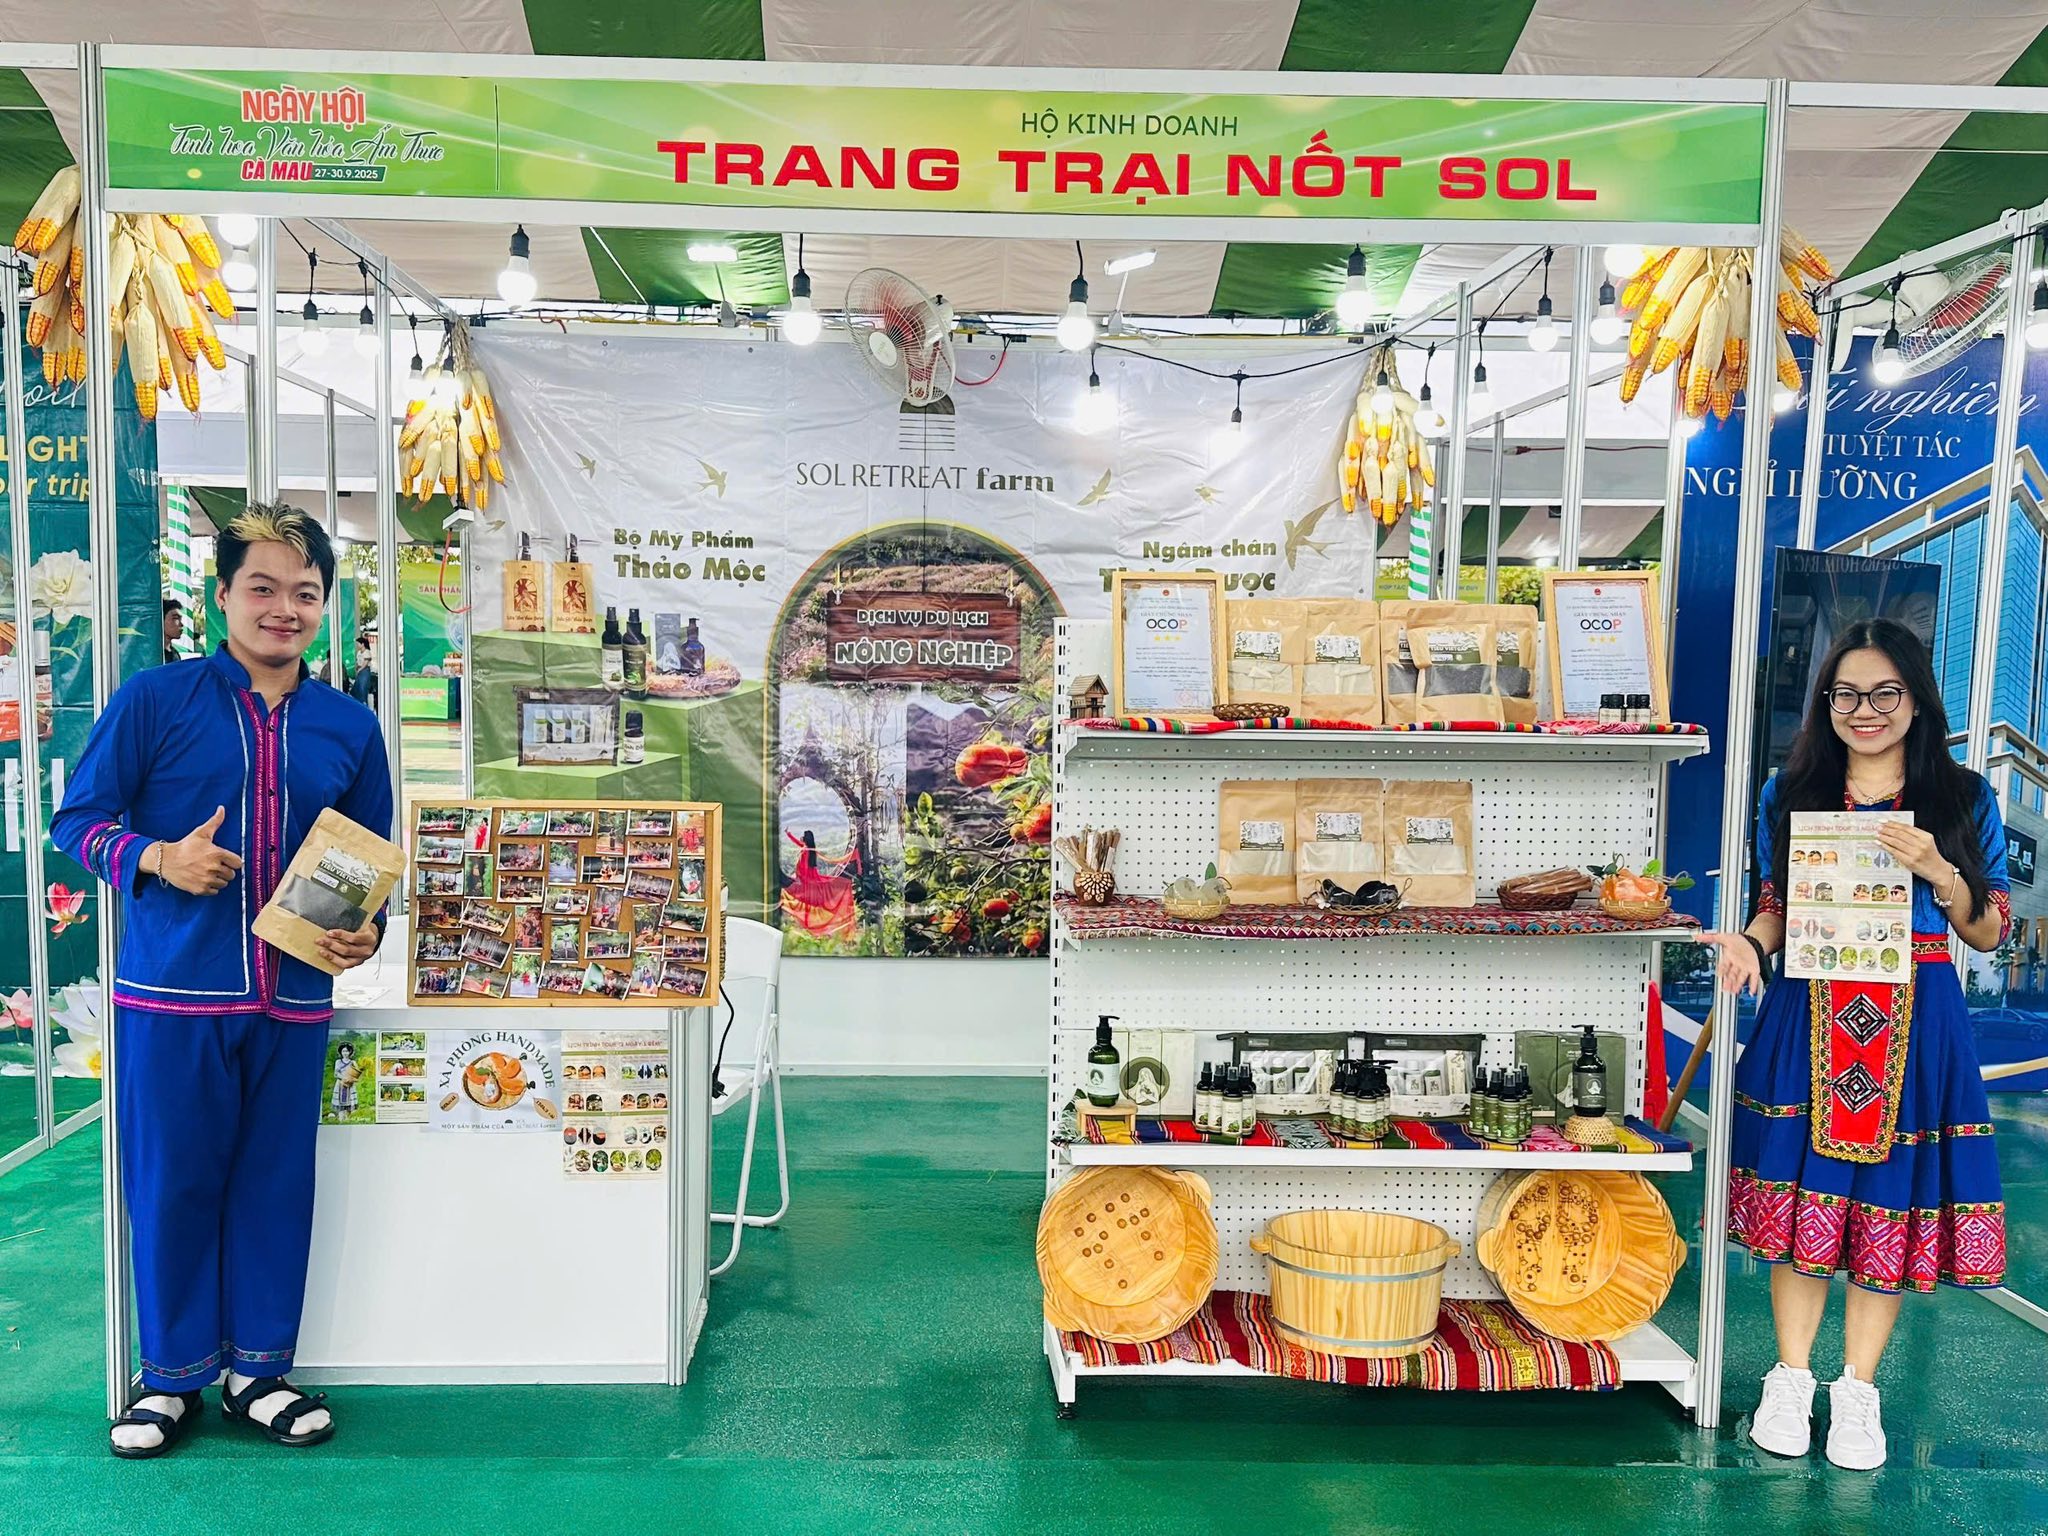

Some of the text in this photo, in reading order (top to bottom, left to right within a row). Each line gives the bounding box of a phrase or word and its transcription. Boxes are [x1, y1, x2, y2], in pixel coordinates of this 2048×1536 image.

[241, 84, 366, 132] NGÀY HỘI
[1021, 108, 1239, 139] HỘ KINH DOANH
[219, 125, 256, 156] hoa
[258, 126, 305, 160] Văn
[310, 127, 345, 157] hóa
[400, 129, 445, 162] Thực
[241, 159, 379, 181] CÀ MAU 27-30.9.2025
[657, 129, 1597, 205] TRANG TRẠI NỐT SOL
[1824, 431, 1962, 461] TUYỆT TÁC
[797, 462, 1056, 493] SOL RETREAT farm
[614, 528, 754, 551] Bộ Mỹ Phẩm
[1143, 538, 1277, 563] Ngâm chân
[613, 554, 766, 588] Thảo Mộc
[857, 609, 989, 628] DỊCH VỤ DU LỊCH
[1146, 618, 1188, 630] OCOP
[1580, 618, 1622, 631] OCOP
[835, 637, 1013, 668] NÔNG NGHIỆP
[496, 1031, 556, 1089] HANDMADE
